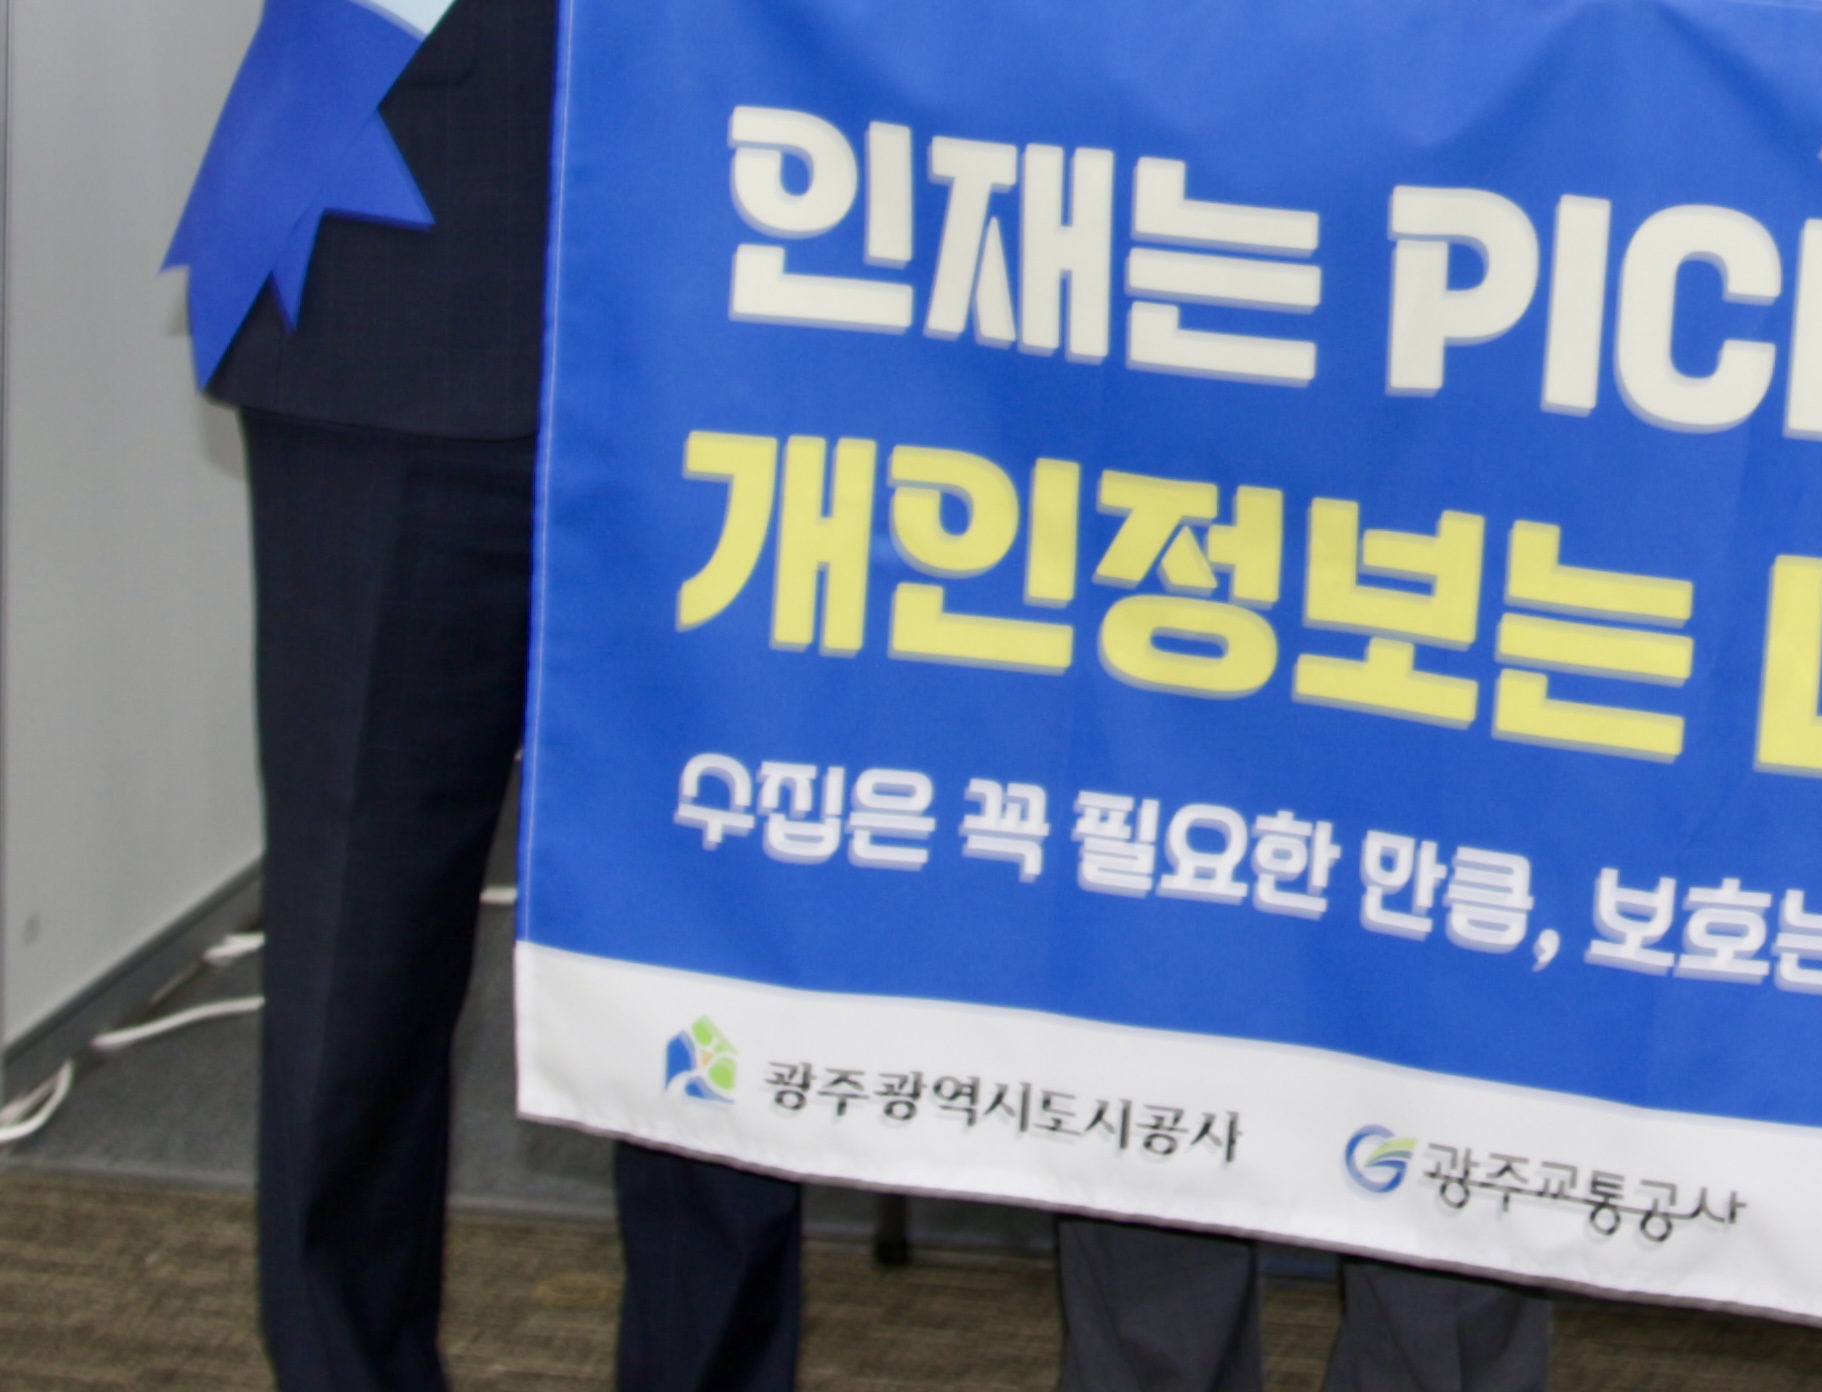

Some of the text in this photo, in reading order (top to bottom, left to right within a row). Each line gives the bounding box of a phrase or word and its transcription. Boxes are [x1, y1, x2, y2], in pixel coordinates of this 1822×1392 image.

[728, 104, 1322, 388] 인재는
[676, 430, 1695, 764] 개인정보는
[674, 752, 937, 871] 수집은
[960, 777, 1050, 883] 꼭
[1072, 789, 1341, 921] 필요한
[1359, 829, 1561, 972] 만큼,
[763, 1060, 1244, 1164] 광주광역시도시공사
[1423, 1141, 1748, 1244] 광주교통공사
